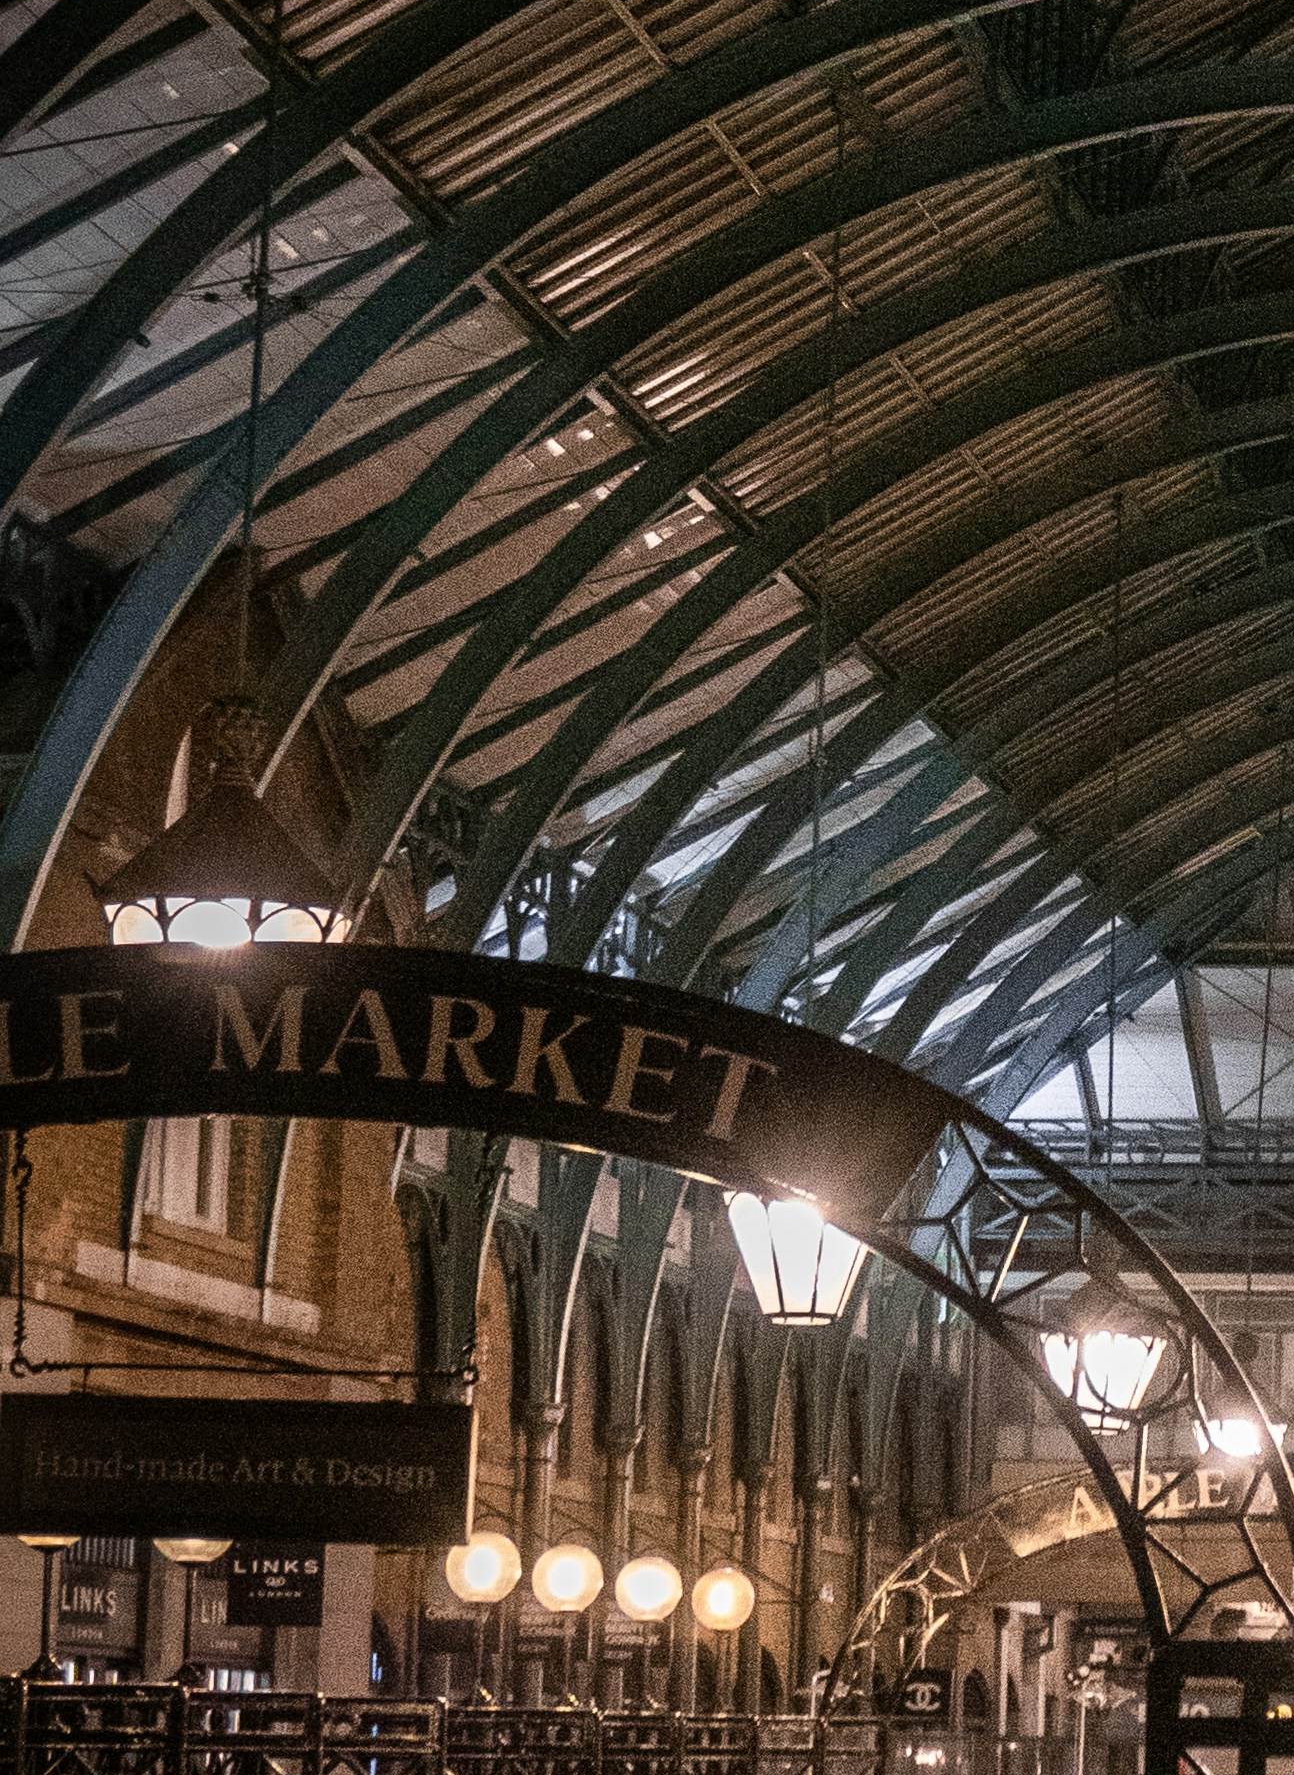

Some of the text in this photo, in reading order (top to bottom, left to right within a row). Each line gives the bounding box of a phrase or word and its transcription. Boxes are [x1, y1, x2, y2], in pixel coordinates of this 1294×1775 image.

[211, 984, 778, 1142] MARKET
[35, 1450, 437, 1493] Hand-made Art & Design
[1063, 1468, 1231, 1536] APLE
[233, 1559, 320, 1574] LINKS
[61, 1583, 117, 1617] LINKS
[201, 1599, 228, 1625] LIN
